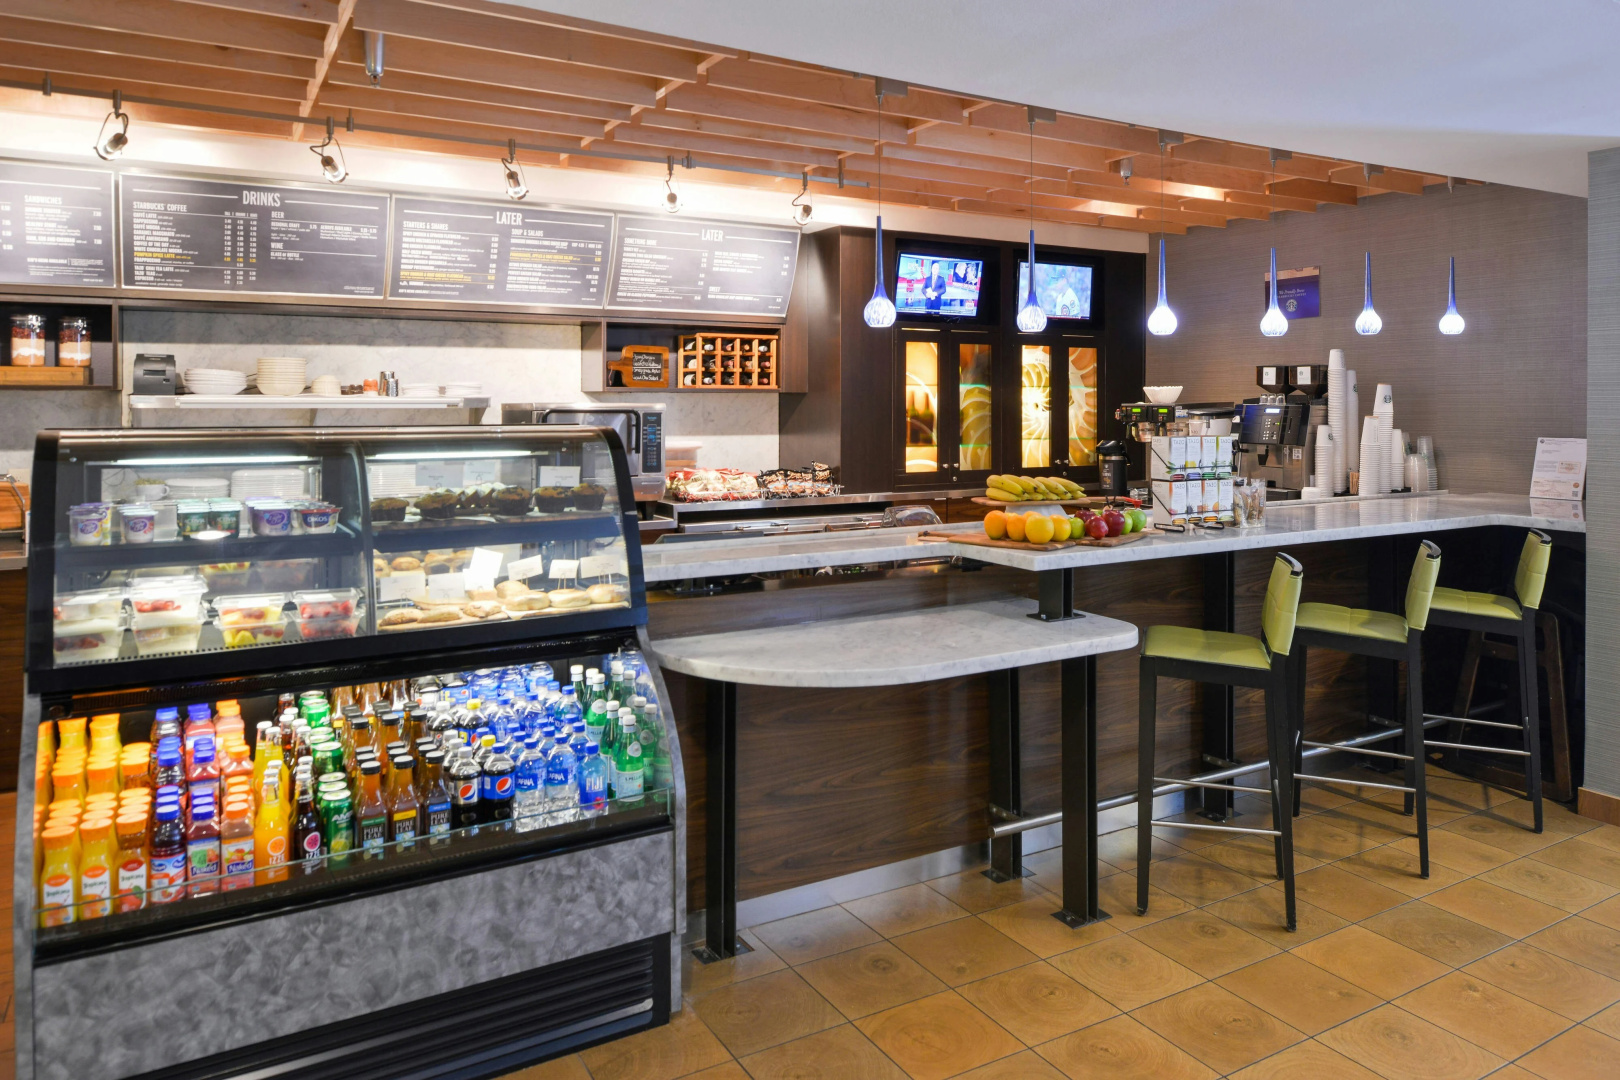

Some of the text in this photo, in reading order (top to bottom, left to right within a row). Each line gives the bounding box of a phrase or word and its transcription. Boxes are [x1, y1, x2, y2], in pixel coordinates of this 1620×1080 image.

[242, 190, 281, 207] DRINKS
[133, 201, 187, 212] STARBUCKS COFFEE
[271, 211, 284, 219] BEER
[496, 211, 523, 225] LATER
[701, 228, 724, 242] LATER
[270, 242, 284, 250] WINE
[307, 514, 328, 523] OIKOS
[586, 777, 604, 791] FIJI
[430, 811, 448, 820] PURE
[396, 819, 414, 829] PURE
[363, 825, 384, 836] PURE
[305, 847, 321, 860] IZZE
[268, 853, 286, 866] IZZE
[228, 860, 253, 874] Naked
[121, 873, 144, 883] Tropicana
[83, 880, 108, 890] Tropicana
[46, 888, 71, 898] Tropicana
